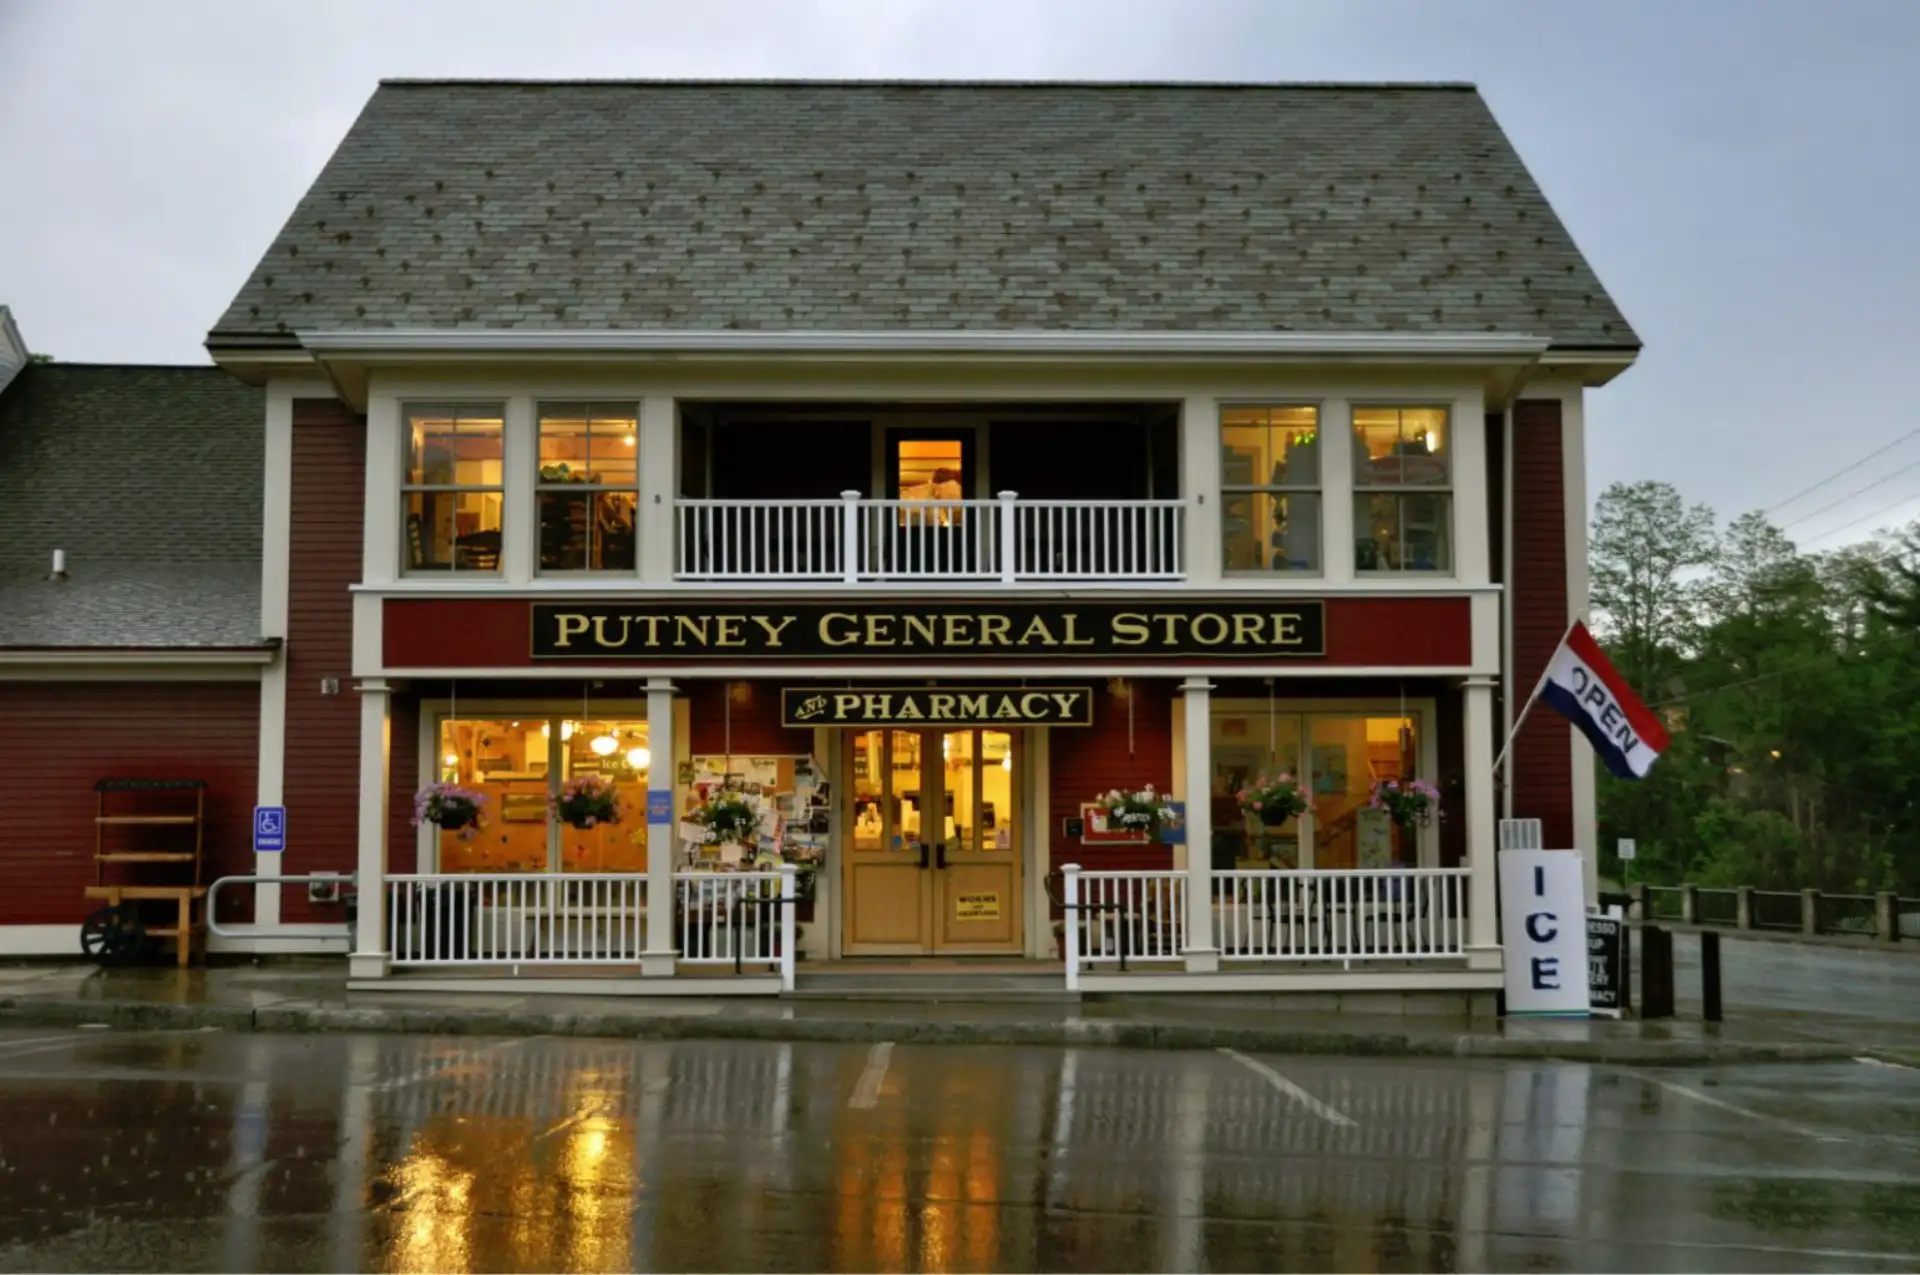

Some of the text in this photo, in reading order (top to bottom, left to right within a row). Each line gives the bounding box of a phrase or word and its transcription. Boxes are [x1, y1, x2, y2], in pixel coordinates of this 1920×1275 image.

[553, 612, 1304, 647] PUTNEY GENERAL STORE
[794, 693, 1081, 720] AND PHARMACY
[1571, 665, 1640, 754] OPEN
[1524, 865, 1562, 991] ICE
